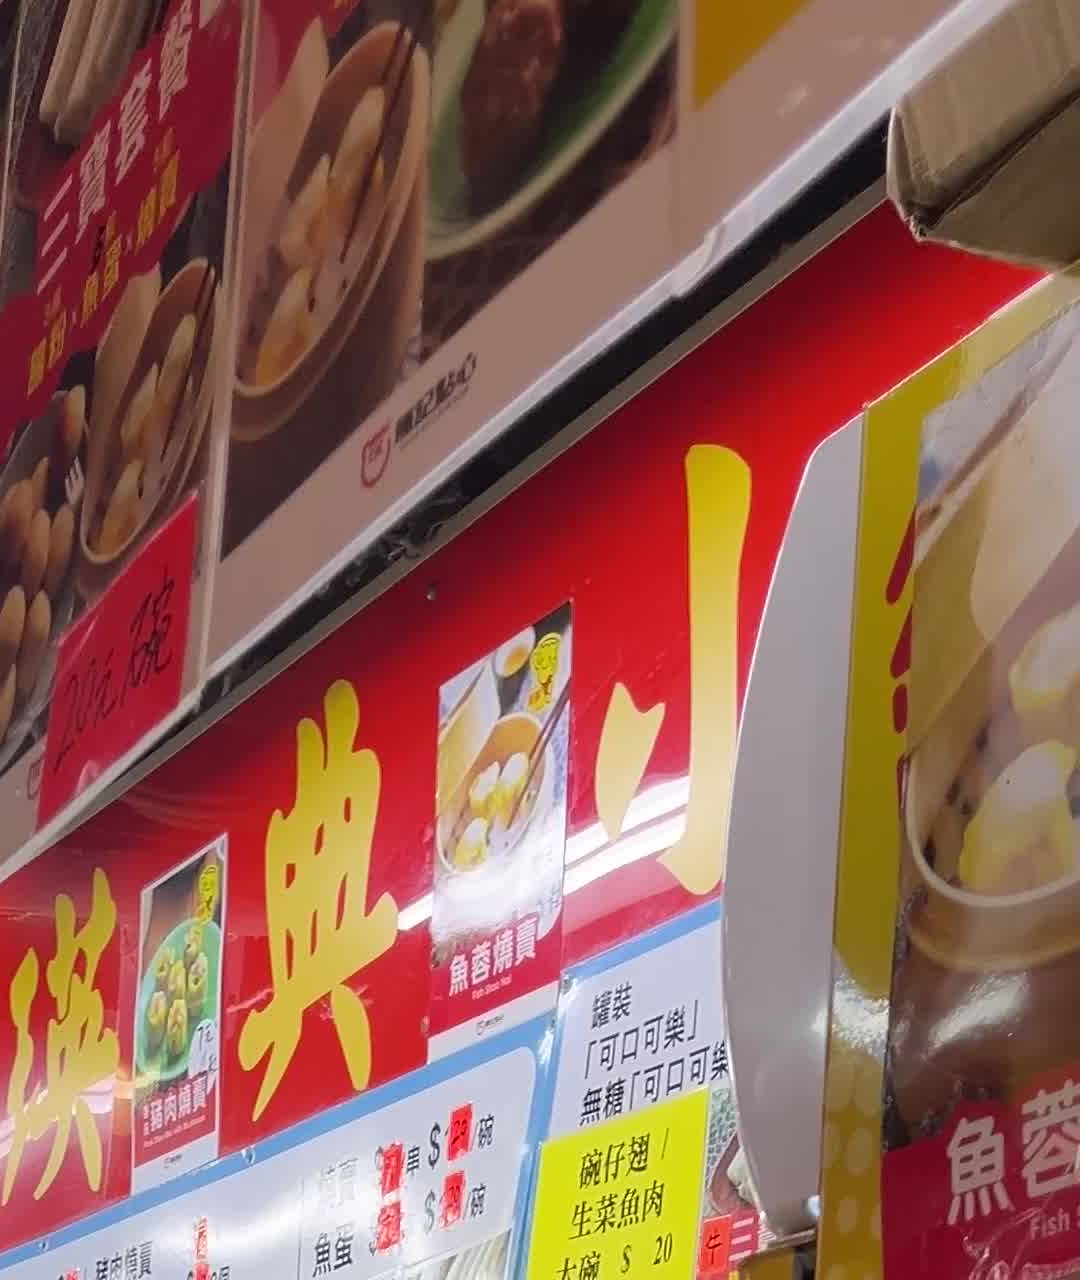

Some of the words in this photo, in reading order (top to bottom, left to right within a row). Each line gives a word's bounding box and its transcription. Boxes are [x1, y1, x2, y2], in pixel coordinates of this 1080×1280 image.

[591, 981, 633, 1030] 罐裝
[579, 1132, 650, 1190] 碗仔翅
[567, 1179, 665, 1241] 生菜魚肉
[1030, 1211, 1070, 1240] Fish
[312, 1225, 353, 1278] 魚蛋
[652, 1232, 673, 1265] 20
